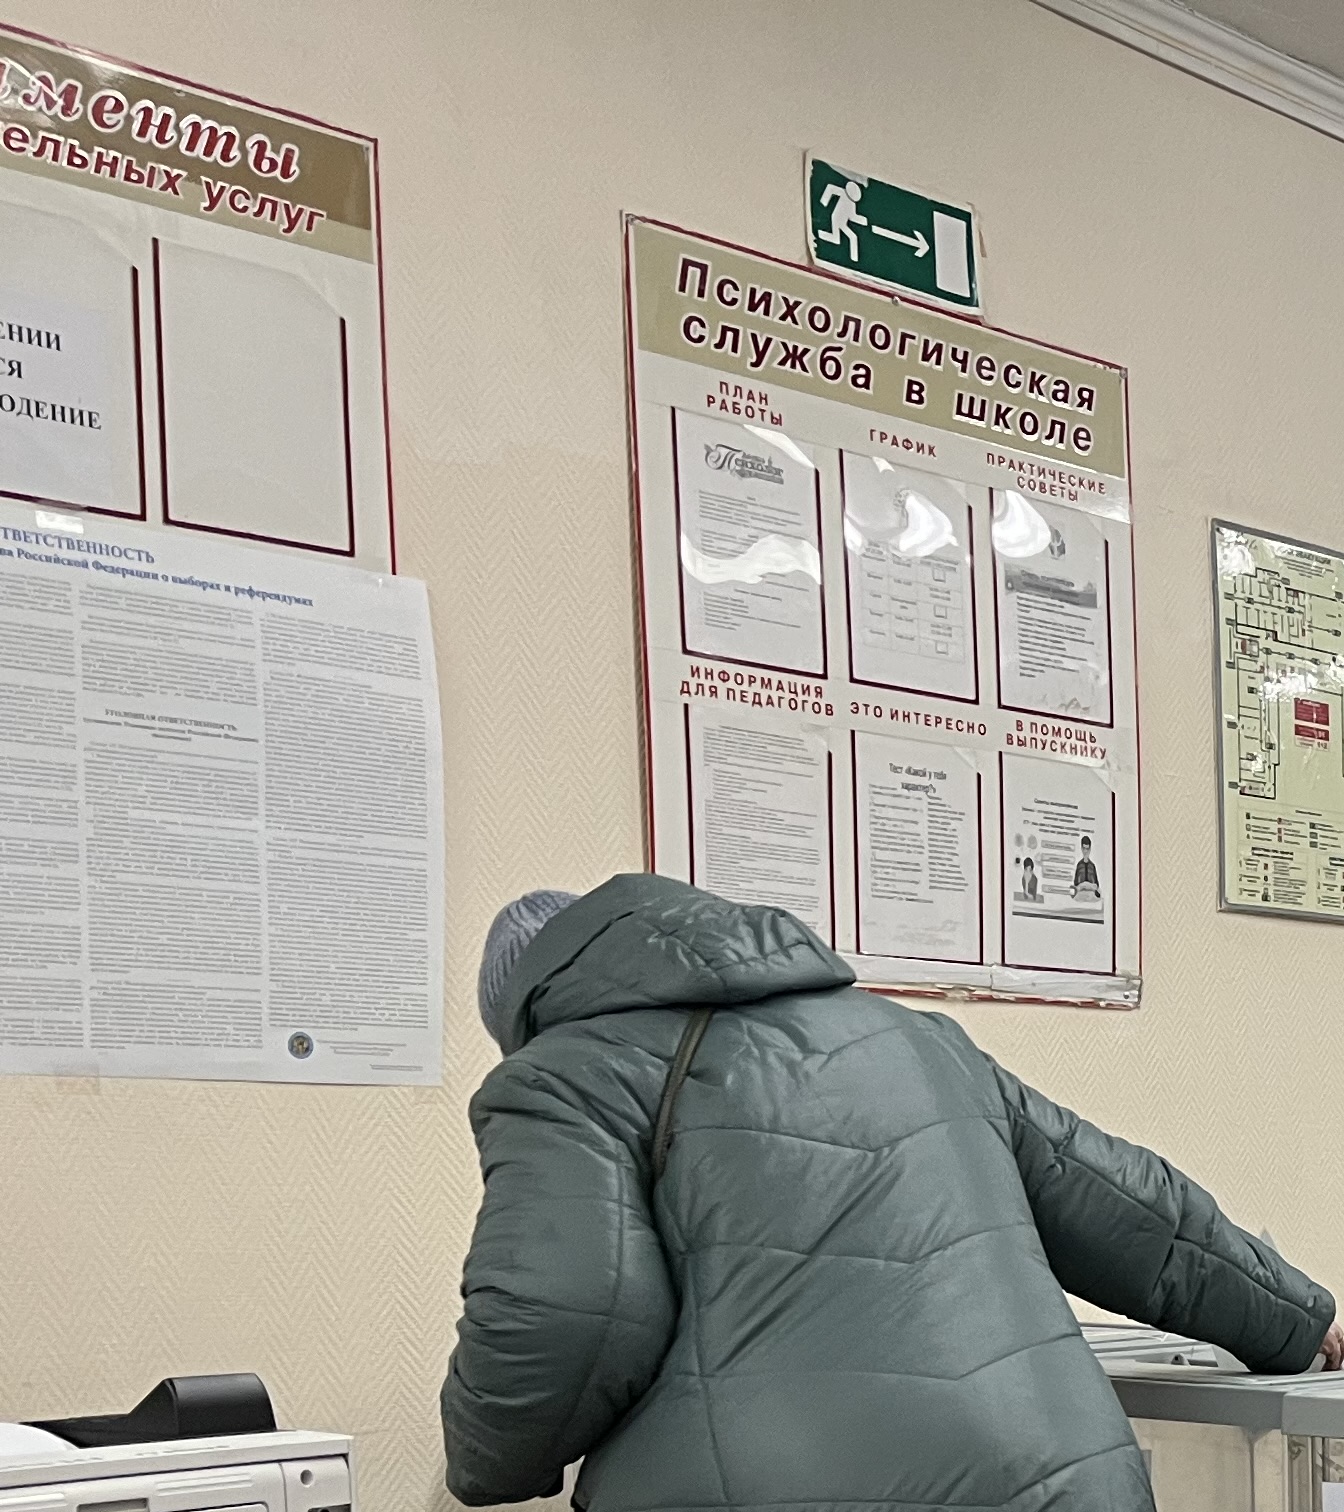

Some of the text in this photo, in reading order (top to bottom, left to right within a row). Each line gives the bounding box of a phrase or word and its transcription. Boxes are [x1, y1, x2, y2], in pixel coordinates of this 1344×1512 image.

[0, 60, 298, 181] менты
[202, 180, 325, 234] услуг
[678, 258, 1095, 412] Психологическая
[682, 314, 1093, 453] служба в школе
[719, 381, 769, 406] ПЛАН
[706, 394, 783, 427] РАБОТЫ
[869, 428, 937, 458] ГРАФИК
[986, 452, 1106, 495] ПРАКТИЧЕСКИЕ
[1017, 476, 1078, 502] СОВЕТЫ
[17, 547, 89, 569] Российской
[92, 559, 159, 578] Федерации
[171, 575, 221, 591] выборах
[680, 680, 834, 716] ДЛЯ ПЕДАГОГОВ
[690, 664, 823, 699] ИНФОРМАЦИЯ
[850, 701, 987, 736] ЭТО ИНТЕРЕСНО
[1016, 719, 1097, 744] В ПОМОЩЬ
[1006, 733, 1107, 760] ВЫПУСКНИКУ
